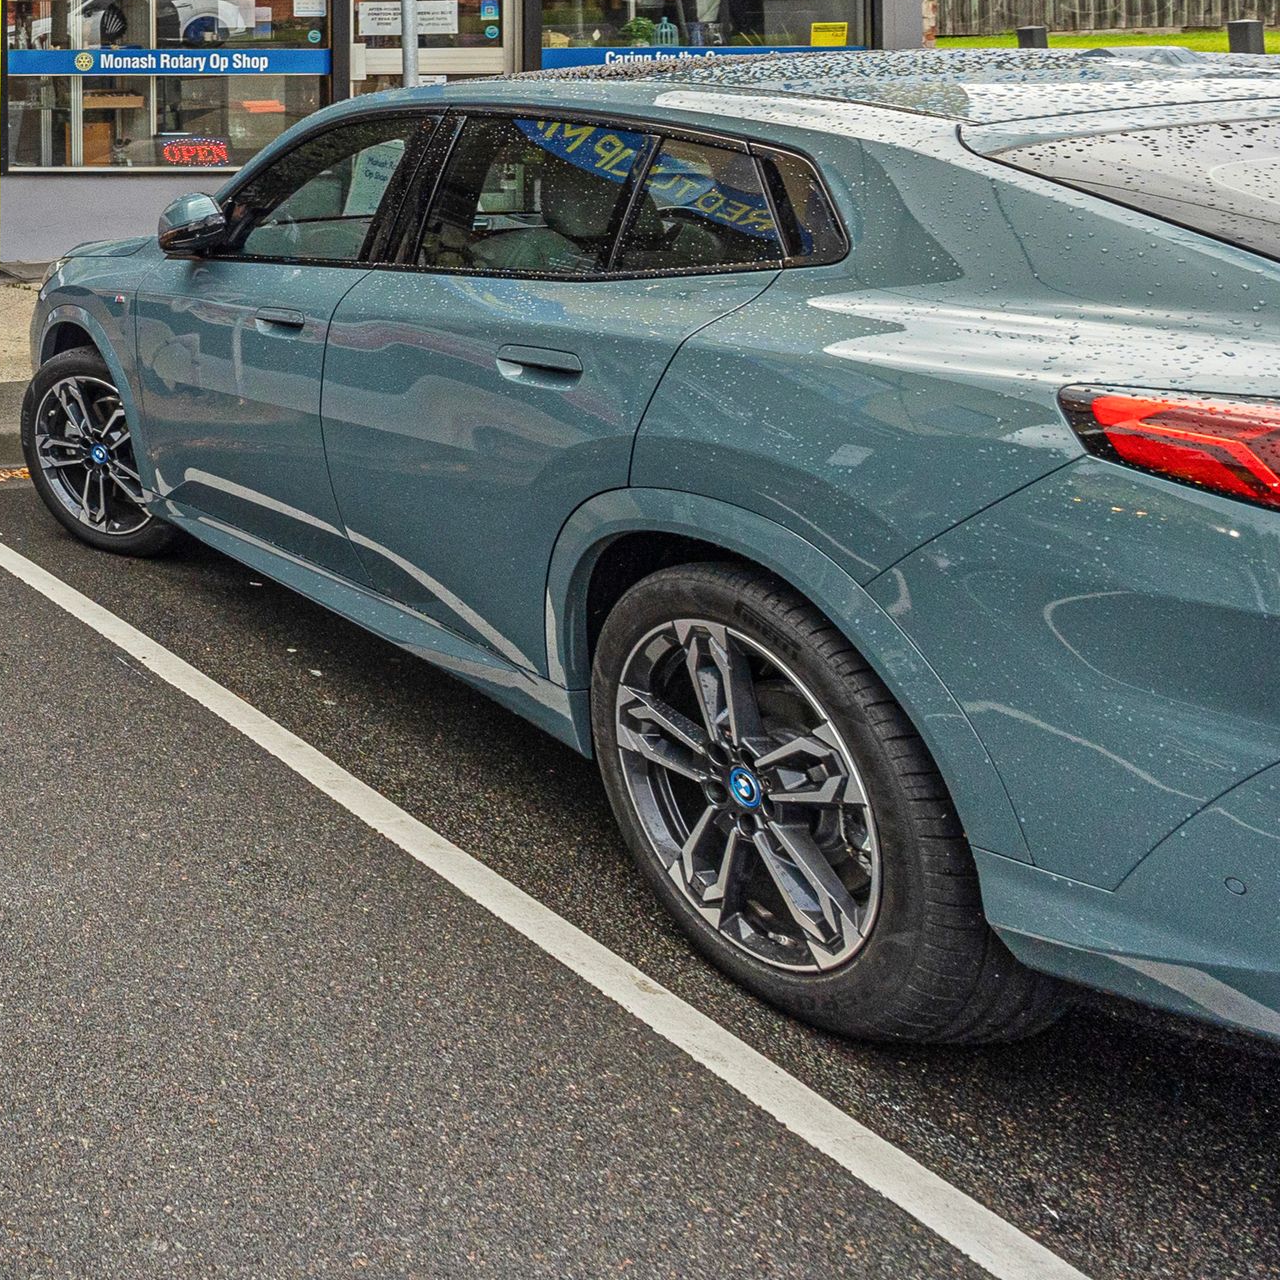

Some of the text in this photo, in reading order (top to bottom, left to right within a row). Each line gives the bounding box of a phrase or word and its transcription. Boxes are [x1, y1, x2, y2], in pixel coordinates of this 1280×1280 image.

[100, 53, 269, 71] Monash Rotary Op Shop
[163, 144, 228, 163] OPEN
